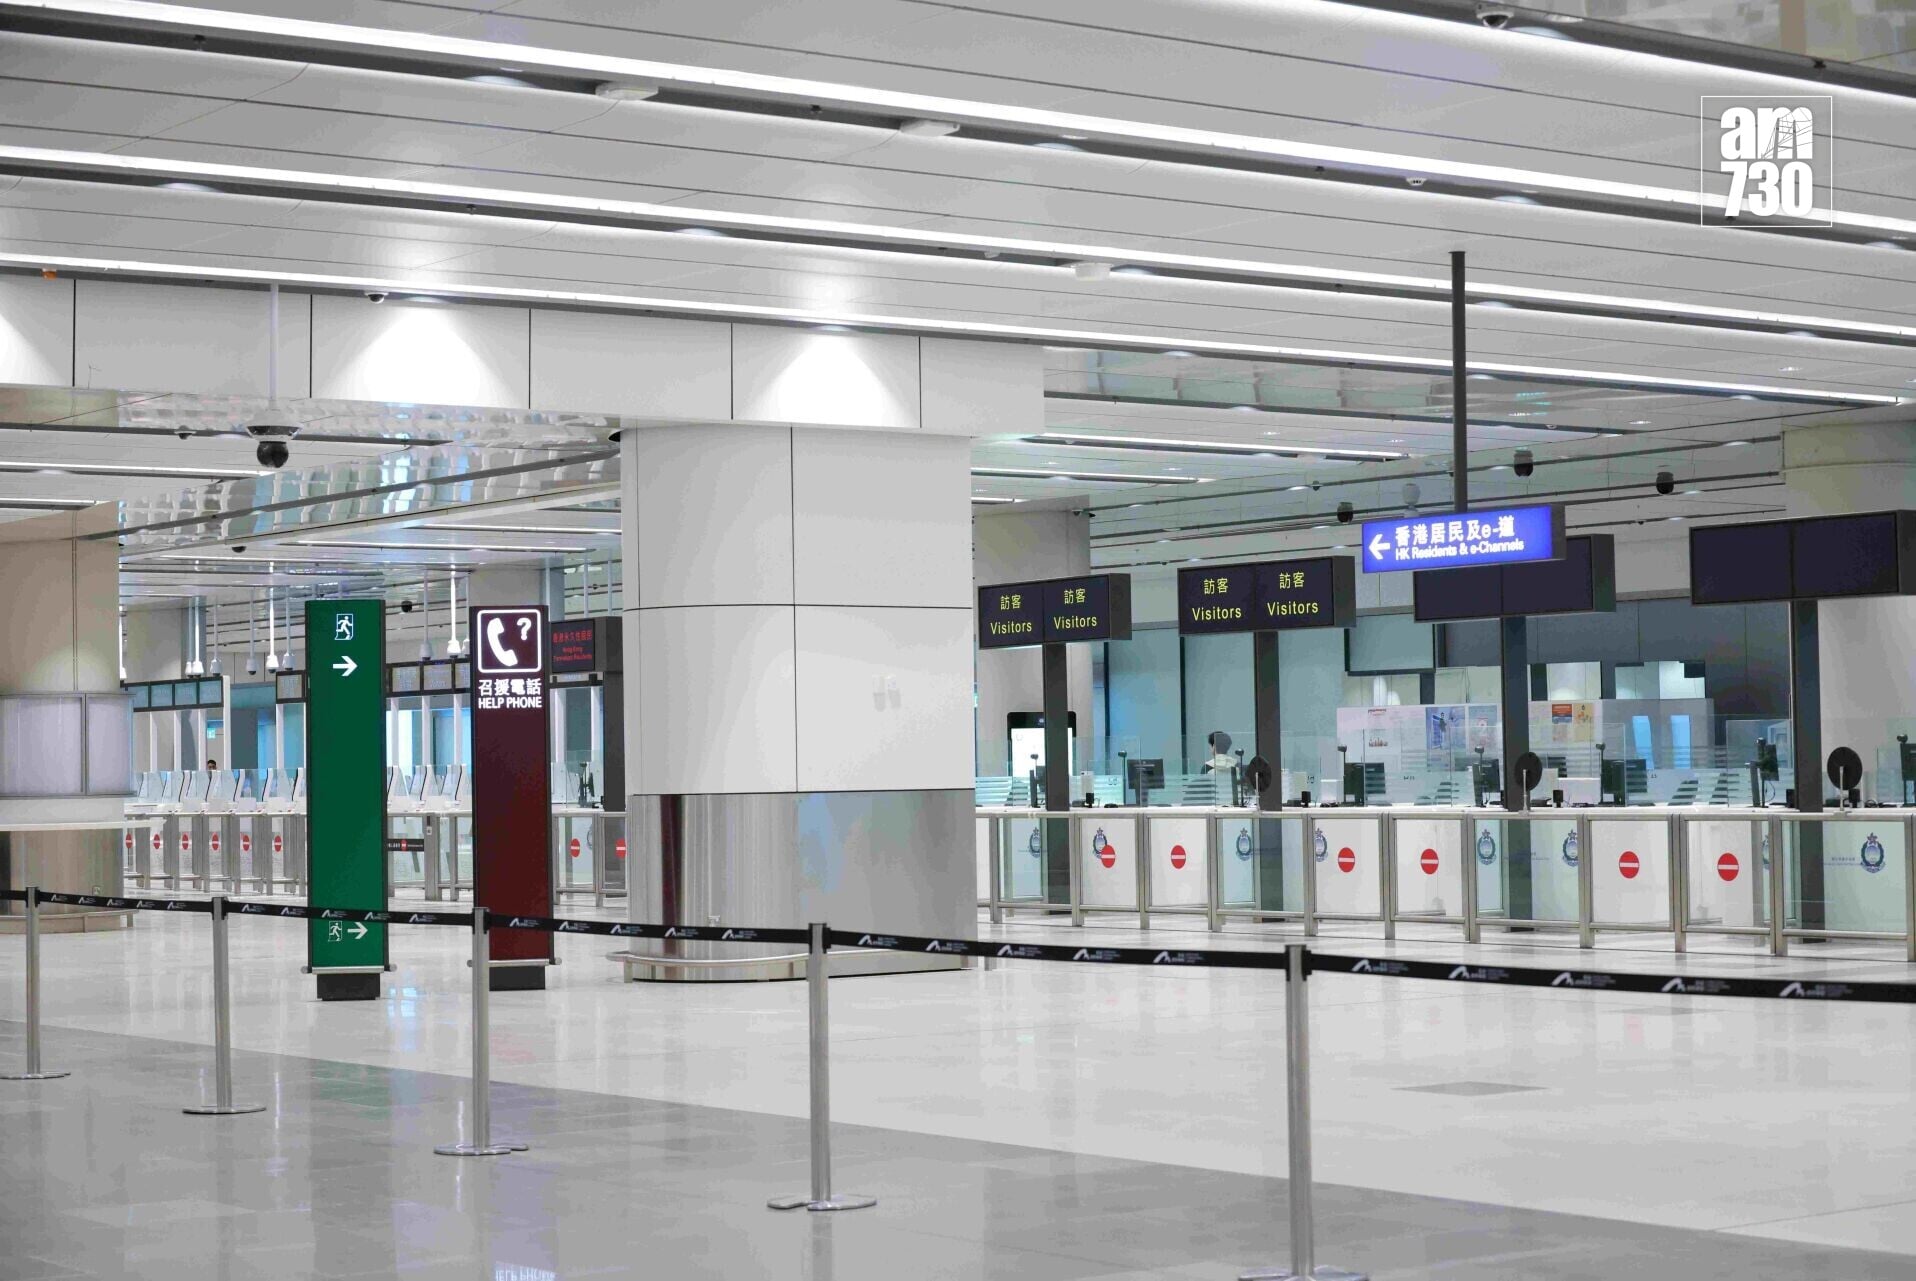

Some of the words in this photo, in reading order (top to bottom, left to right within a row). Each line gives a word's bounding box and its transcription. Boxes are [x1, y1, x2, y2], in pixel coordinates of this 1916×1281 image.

[1395, 515, 1515, 547] 香港居民及e-道
[1395, 547, 1410, 560] HK
[1411, 544, 1457, 559] Residents
[1459, 542, 1469, 554] &
[1470, 538, 1525, 555] e-Channels
[1203, 578, 1229, 595] 訪客
[1279, 571, 1305, 589] 訪客
[1000, 594, 1022, 610] 訪客
[1063, 588, 1086, 604] 訪客
[1192, 606, 1242, 621] Visitors
[1267, 601, 1319, 616] Visitors
[990, 621, 1033, 635] Visitors
[1053, 615, 1098, 630] Visitors
[478, 678, 542, 696] 召援電話
[478, 697, 504, 709] HELP
[506, 696, 542, 708] PHONE
